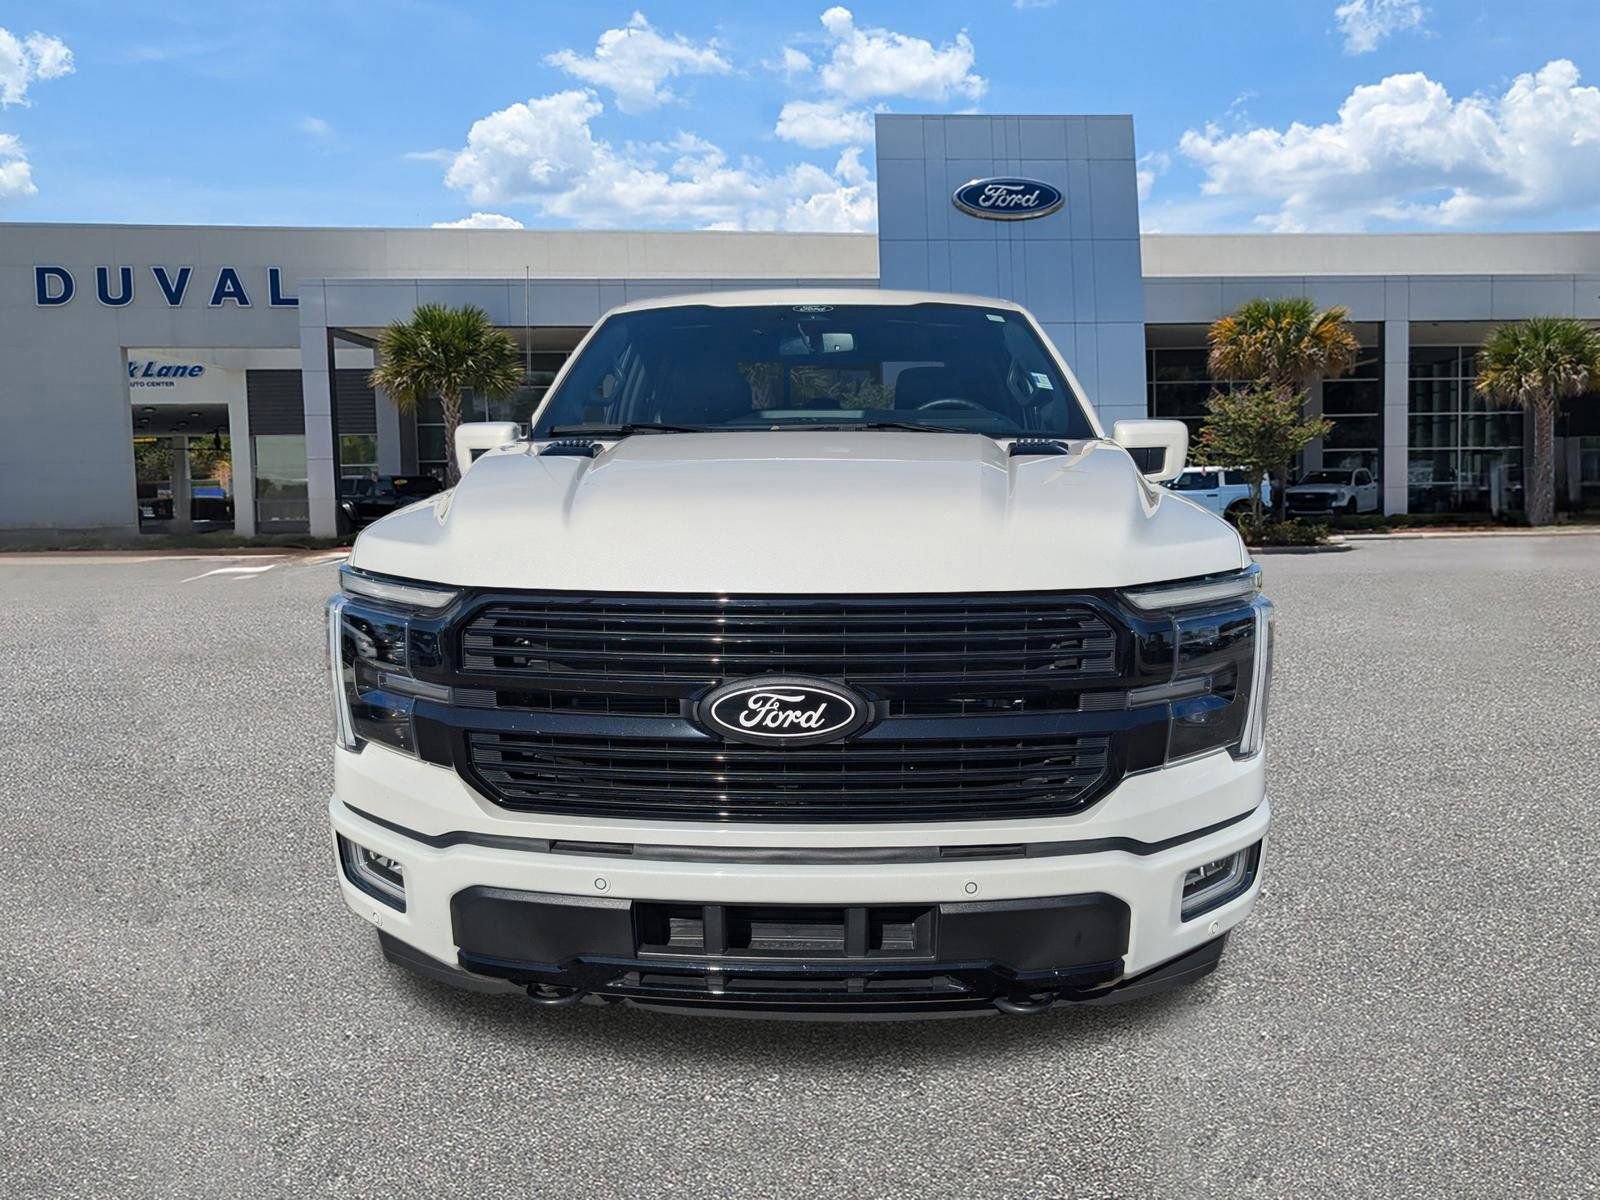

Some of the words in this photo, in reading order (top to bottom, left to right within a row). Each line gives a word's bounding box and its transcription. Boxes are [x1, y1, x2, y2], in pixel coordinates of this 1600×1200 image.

[979, 184, 1040, 207] Ford
[34, 266, 299, 307] DUVAL
[127, 361, 138, 378] k
[141, 361, 205, 378] Lane
[739, 693, 827, 728] Ford
